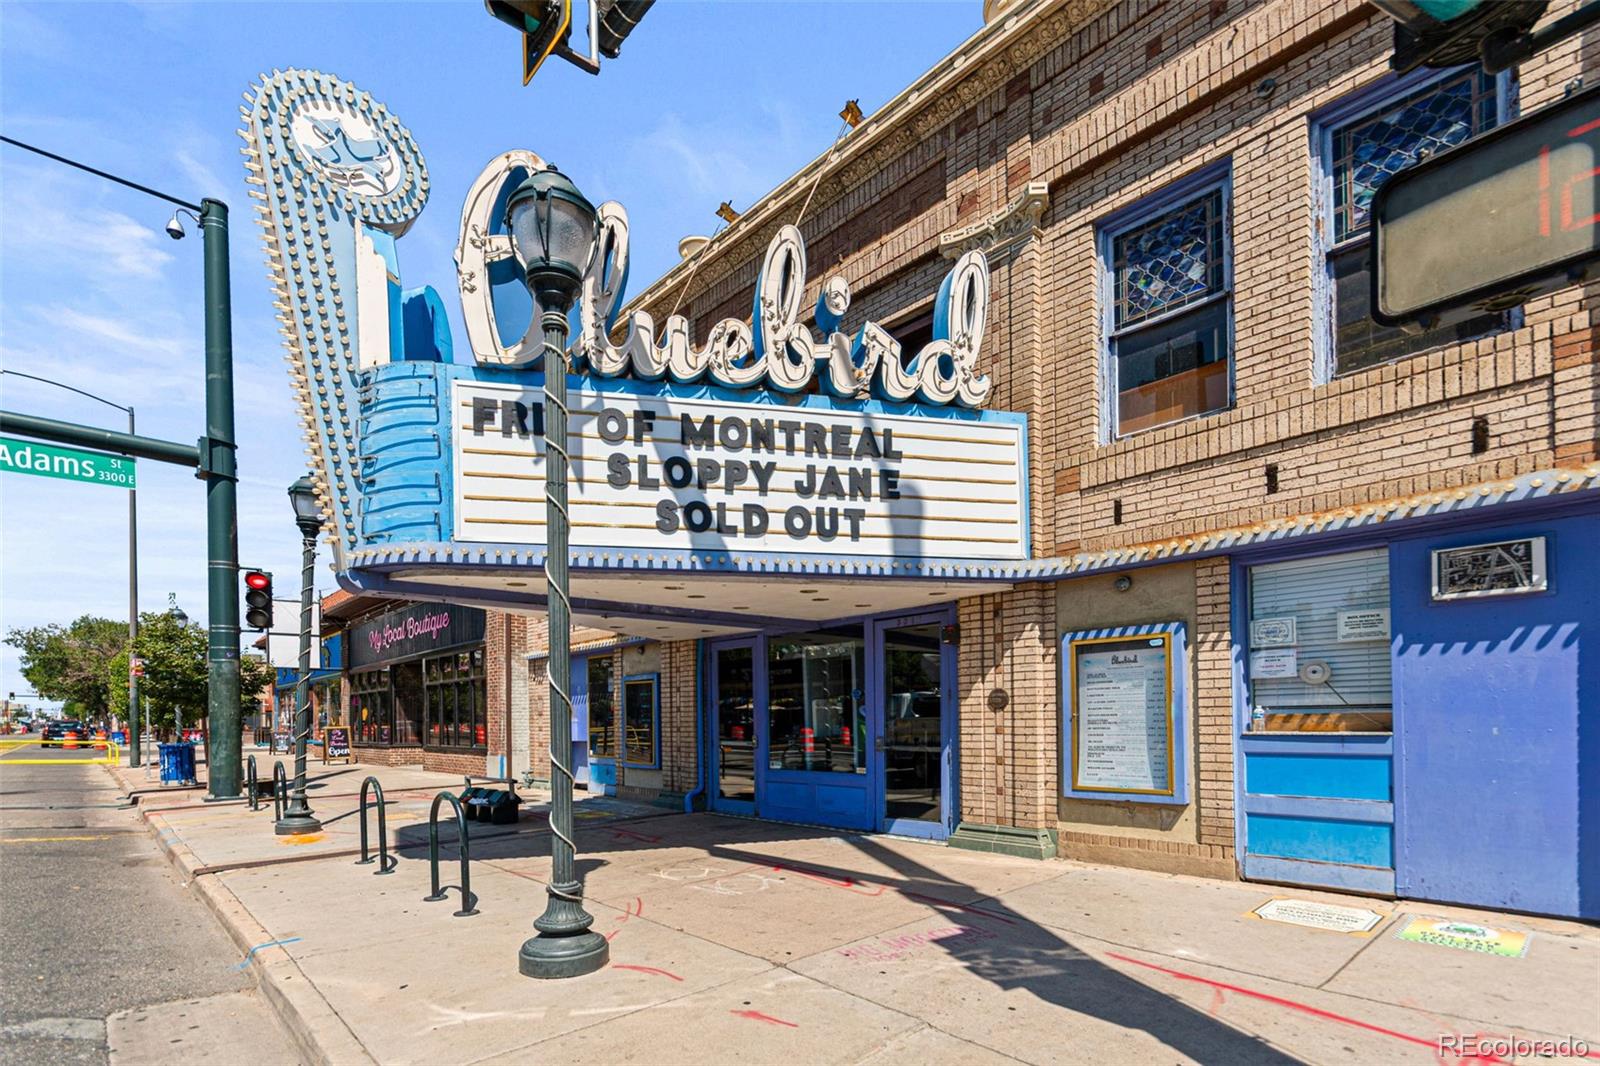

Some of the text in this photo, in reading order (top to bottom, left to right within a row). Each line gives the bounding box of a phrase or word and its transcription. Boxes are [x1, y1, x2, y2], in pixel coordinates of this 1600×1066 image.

[473, 397, 903, 462] FRI OF MONTREAL
[0, 444, 122, 478] Adams St
[98, 470, 135, 485] 3300 E
[607, 452, 901, 500] SLOPPY JANE
[656, 499, 866, 542] SOLD OUT
[368, 612, 450, 653] My Local Boutique
